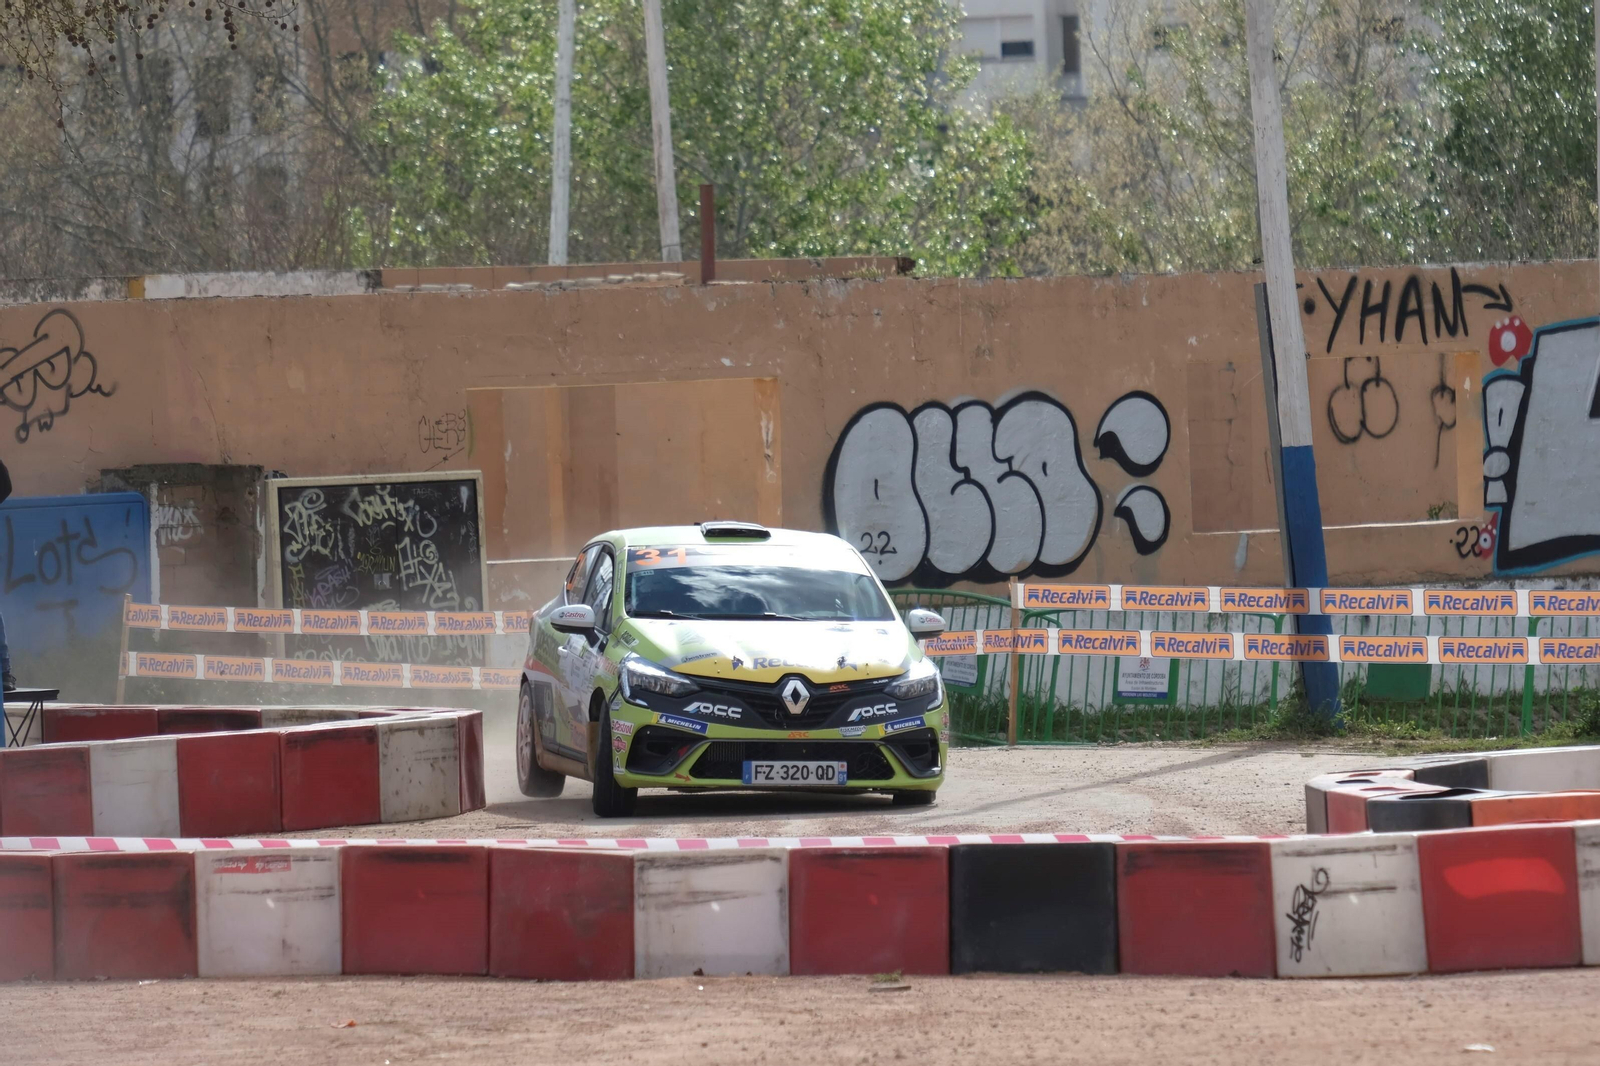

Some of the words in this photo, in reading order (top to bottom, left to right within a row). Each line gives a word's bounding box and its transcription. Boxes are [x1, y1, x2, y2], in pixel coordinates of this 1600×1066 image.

[635, 547, 687, 566] 31
[1040, 588, 1093, 605] Recalvi
[1138, 591, 1192, 607] Recalvi
[1237, 592, 1291, 608] Recalvi
[1338, 593, 1394, 610] Recalvi
[1442, 595, 1499, 611] Recalvi
[1547, 595, 1600, 611] Recalv
[126, 608, 150, 622] calvi
[180, 610, 216, 626] Recalvi
[246, 613, 283, 628] Recalvi
[312, 615, 349, 630] Recalvi
[379, 616, 417, 631] Recalvi
[448, 617, 484, 631] Recalvi
[992, 633, 1033, 649] Recalvi
[1075, 634, 1125, 650] Recalvi
[1167, 636, 1217, 654] Recalvi
[1260, 639, 1311, 656] Recalvi
[1356, 641, 1411, 658] Recalvi
[1456, 642, 1510, 658] Recalvi
[1556, 643, 1600, 659] Recal
[149, 658, 185, 673] Recalvi
[216, 660, 253, 676] Recalvi
[284, 663, 322, 679] Recalvi
[353, 666, 391, 682] Recalvi
[421, 669, 461, 684] Recalvi
[667, 718, 701, 730] MICHELIN
[893, 720, 921, 729] MICHELIN
[838, 774, 847, 782] 91
